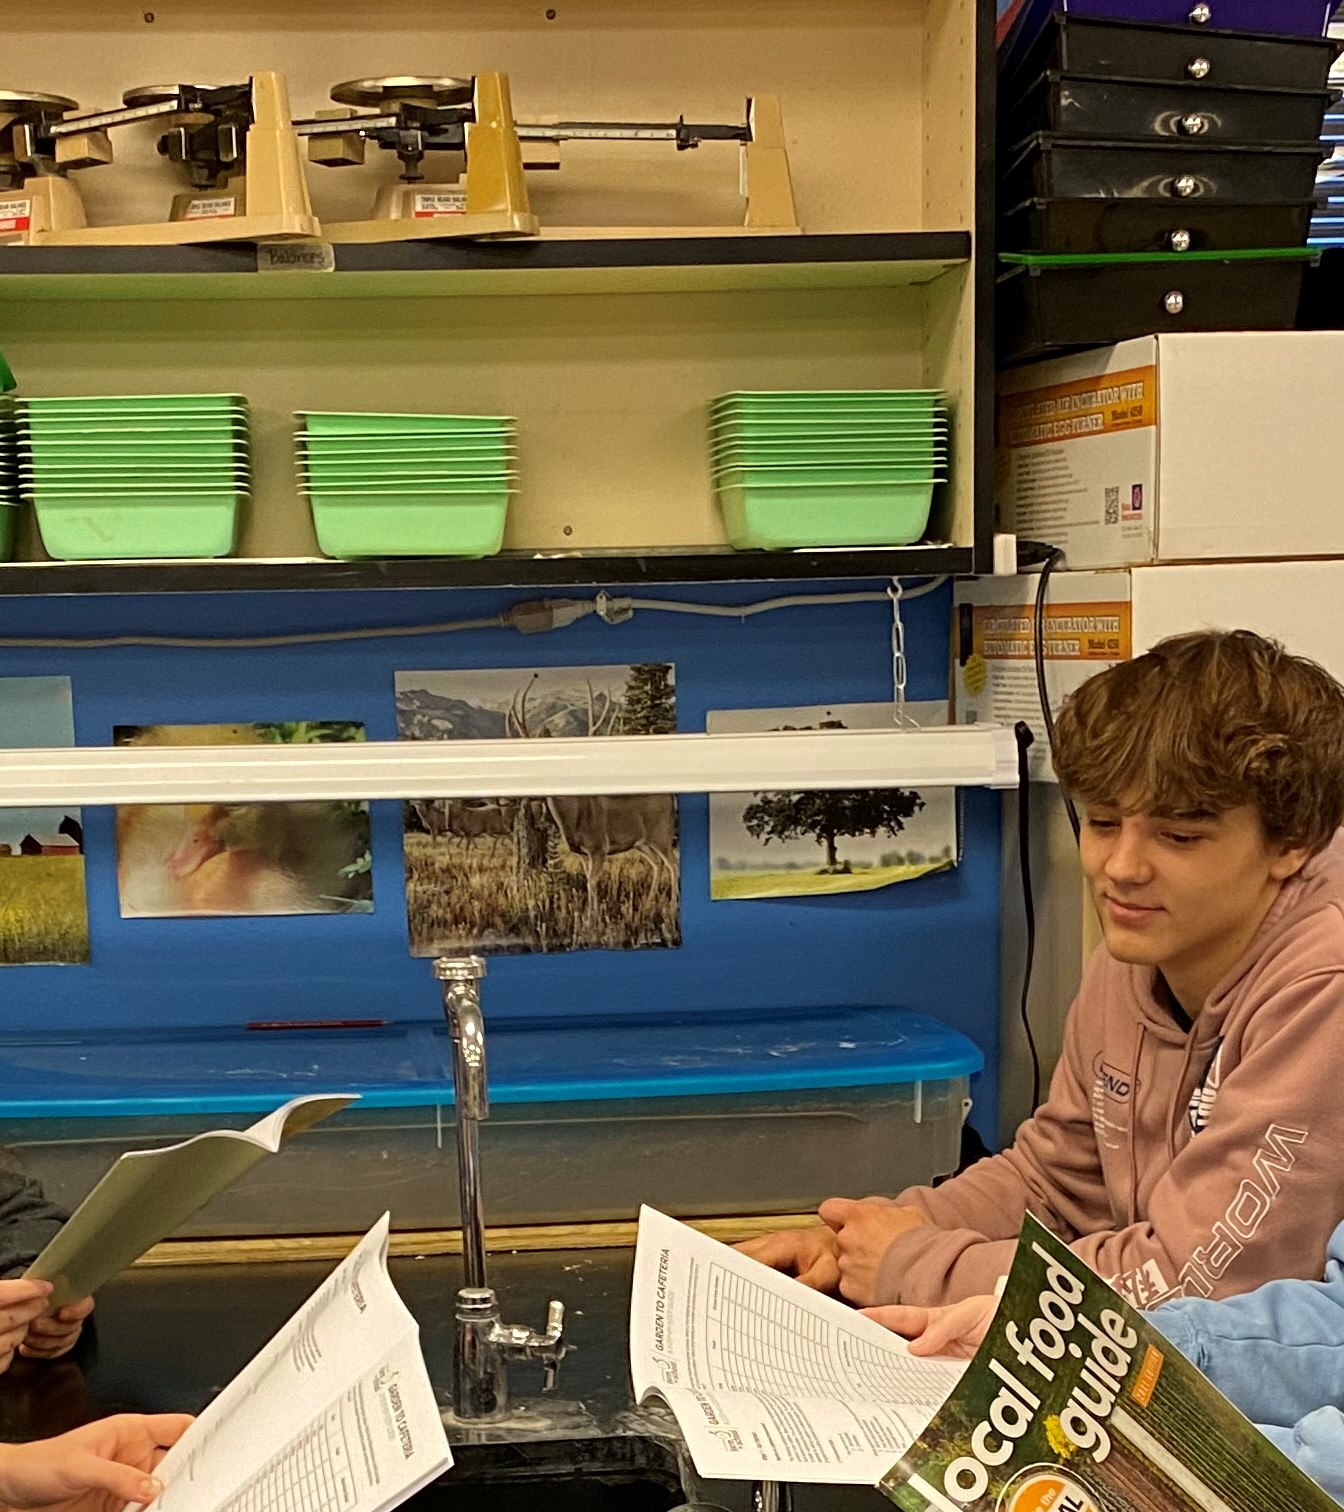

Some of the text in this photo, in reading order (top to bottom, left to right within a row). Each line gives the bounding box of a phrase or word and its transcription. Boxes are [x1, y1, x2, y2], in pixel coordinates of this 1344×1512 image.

[655, 1249, 670, 1352] GARDEN TO CAFETERIA
[1004, 1241, 1086, 1384] food
[1058, 1307, 1139, 1464] guide
